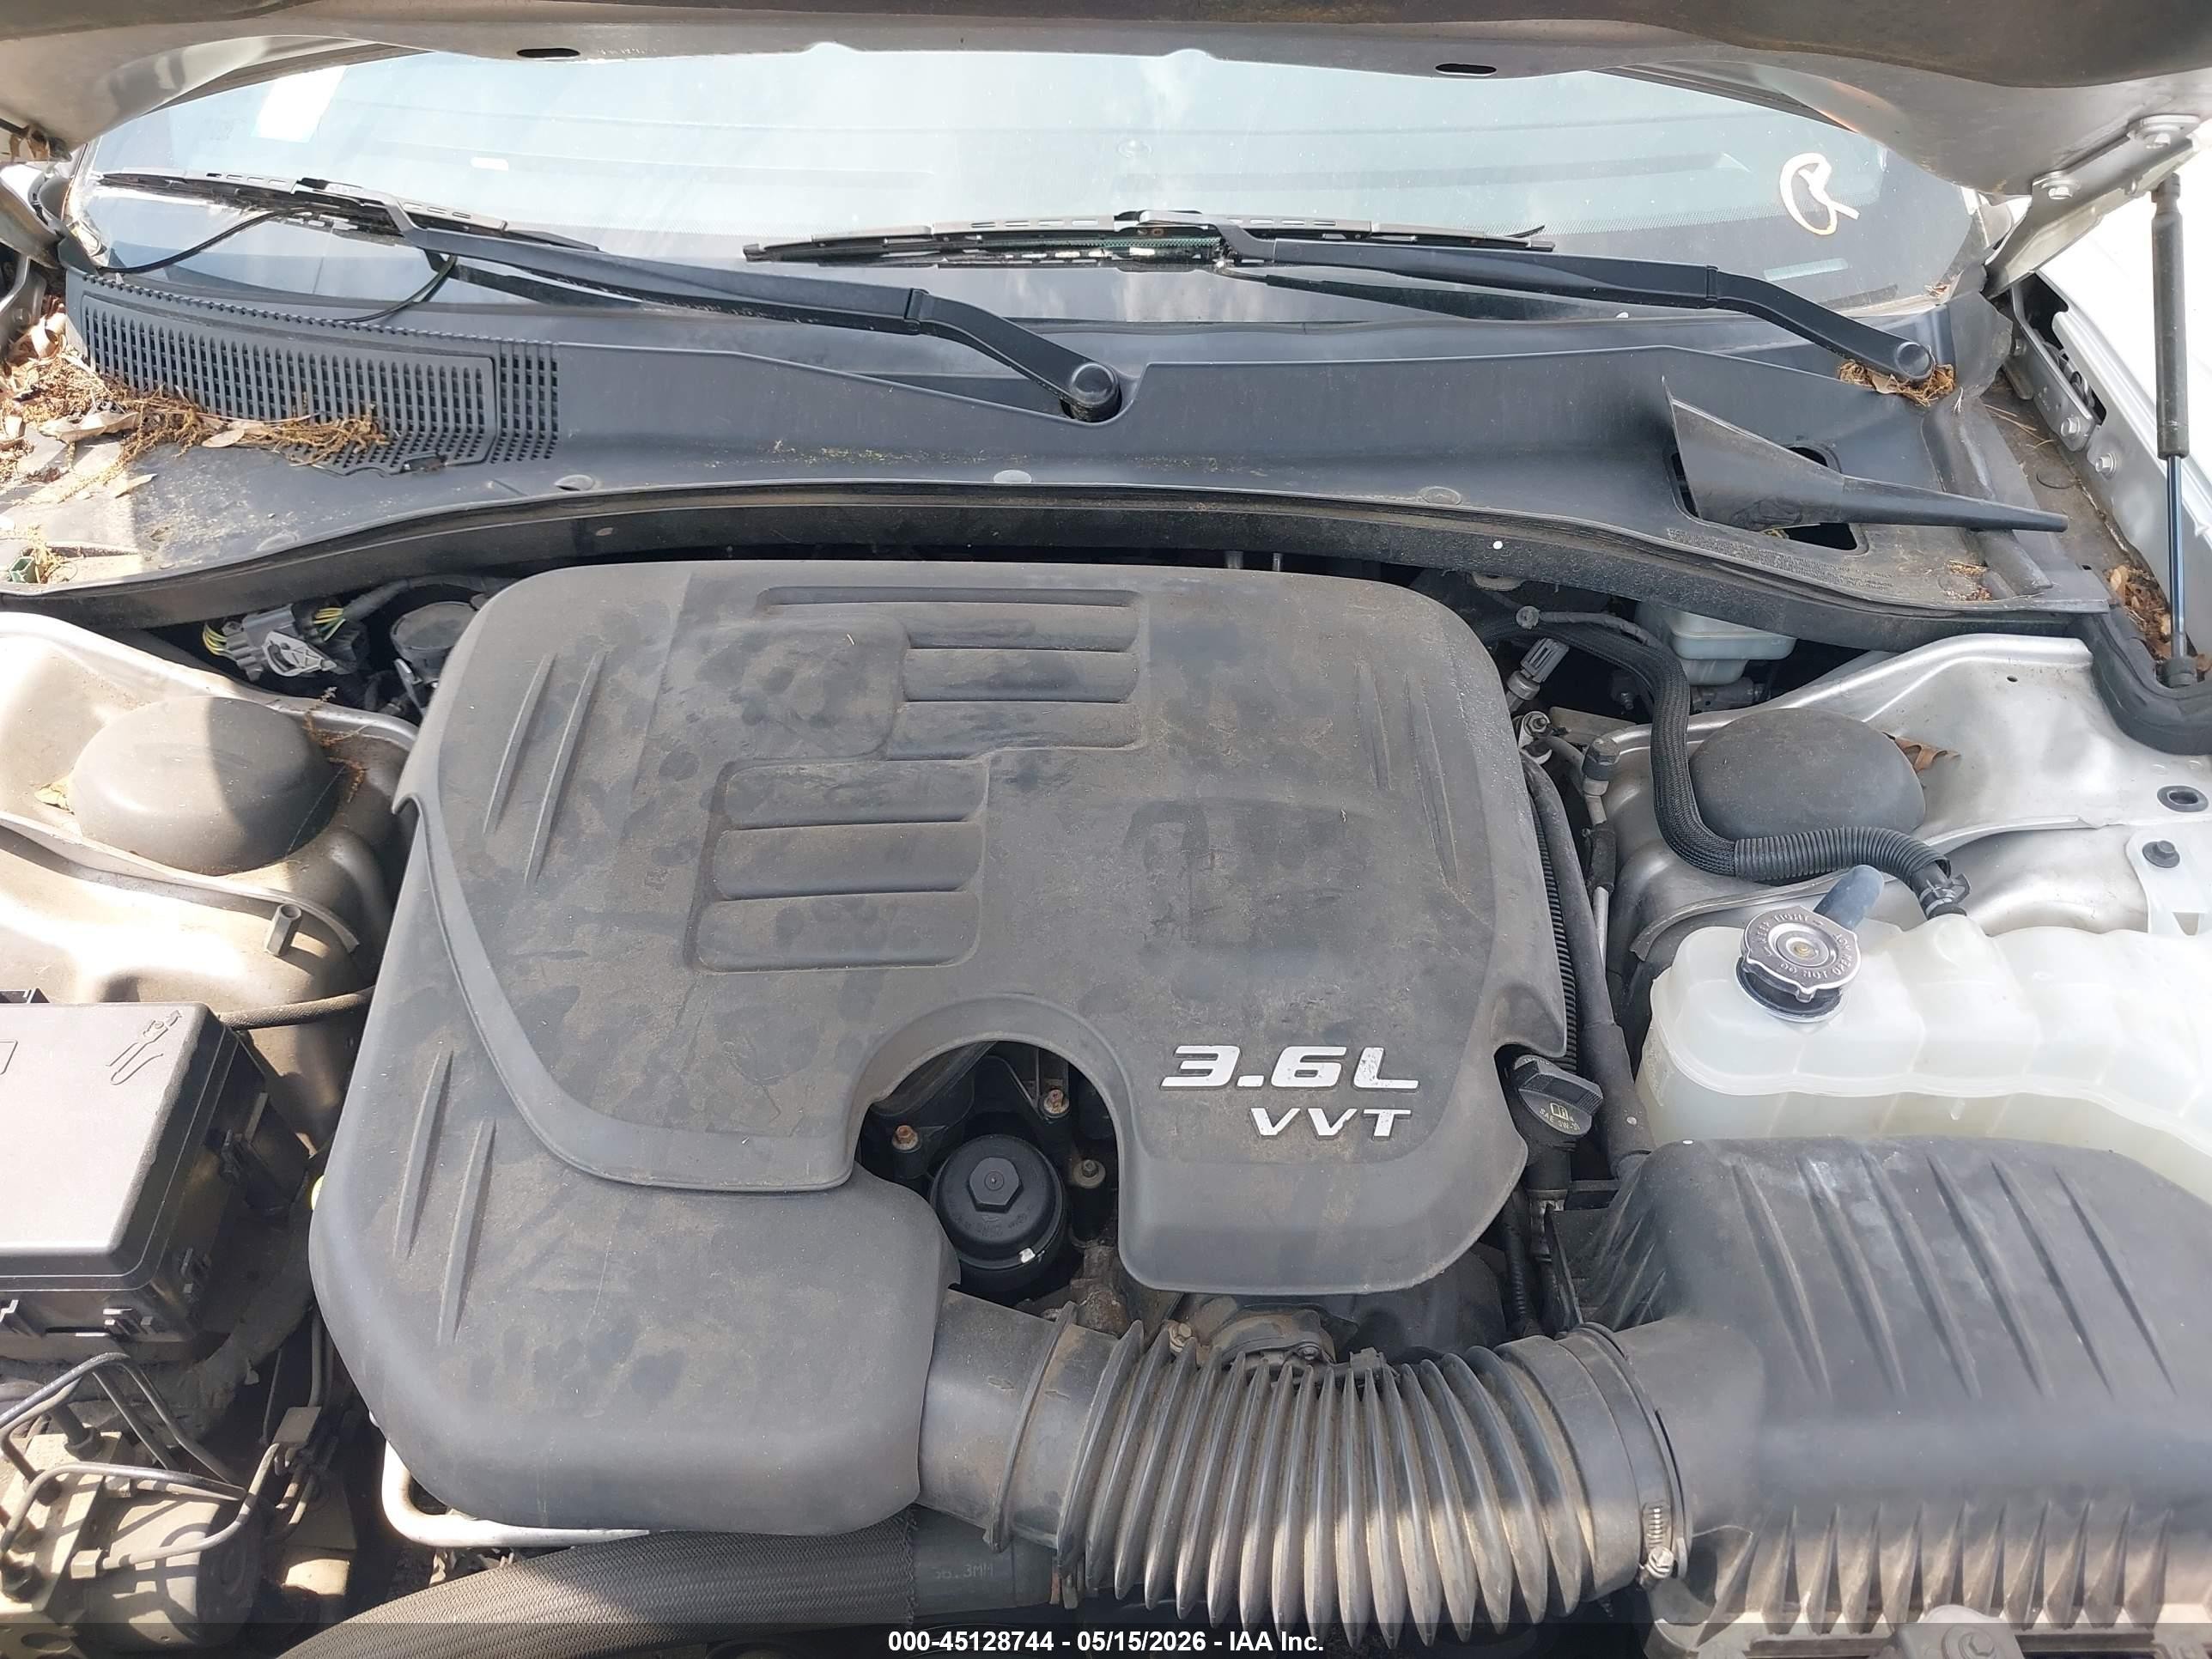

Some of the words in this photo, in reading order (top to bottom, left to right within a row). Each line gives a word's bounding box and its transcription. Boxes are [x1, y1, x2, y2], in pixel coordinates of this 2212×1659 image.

[1780, 963, 1798, 975] DO
[1803, 970, 1829, 980] NOT
[1832, 955, 1853, 975] OPEN
[1161, 1045, 1419, 1090] 3.6L
[1250, 1108, 1412, 1138] VVT
[1540, 1108, 1554, 1123] SAE
